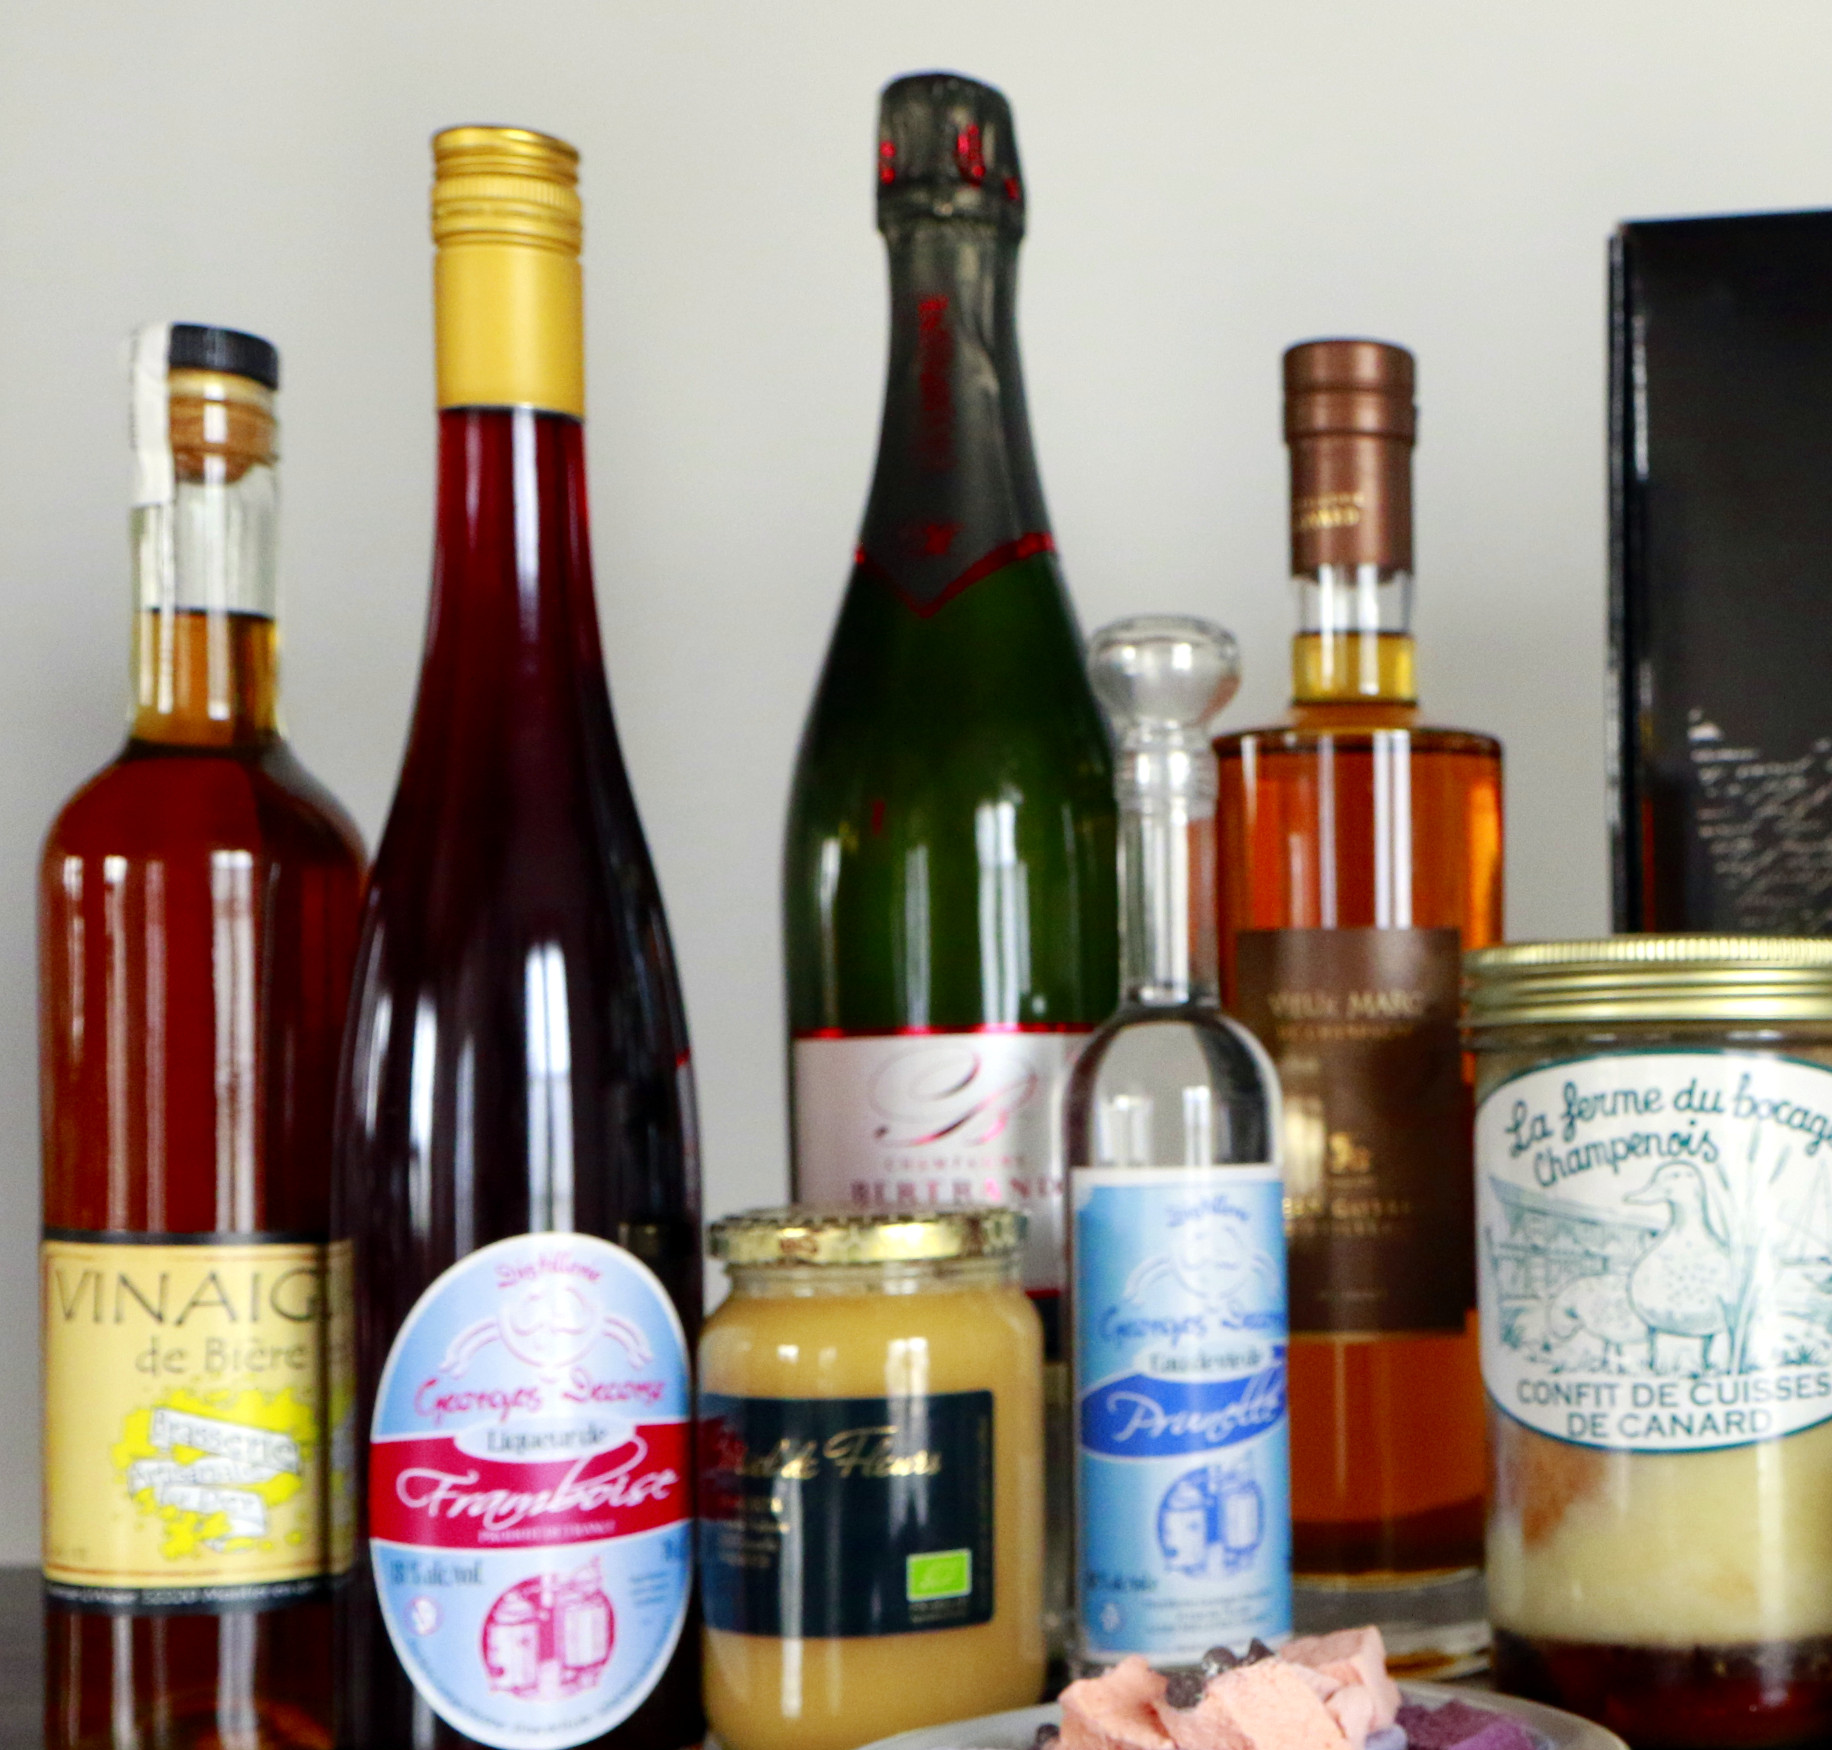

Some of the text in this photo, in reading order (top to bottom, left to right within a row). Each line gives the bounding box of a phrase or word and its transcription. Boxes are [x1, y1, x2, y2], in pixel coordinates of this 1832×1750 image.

[1505, 1100, 1555, 1159] La
[1560, 1080, 1662, 1144] ferme
[1673, 1078, 1725, 1113] du
[1533, 1120, 1721, 1188] Champenois
[135, 1336, 308, 1376] de Bière
[414, 1377, 543, 1426] Georges
[1516, 1373, 1832, 1409] CONFIT DE CUISSES
[1566, 1409, 1774, 1438] DE CANARD
[396, 1435, 680, 1531] Framboise
